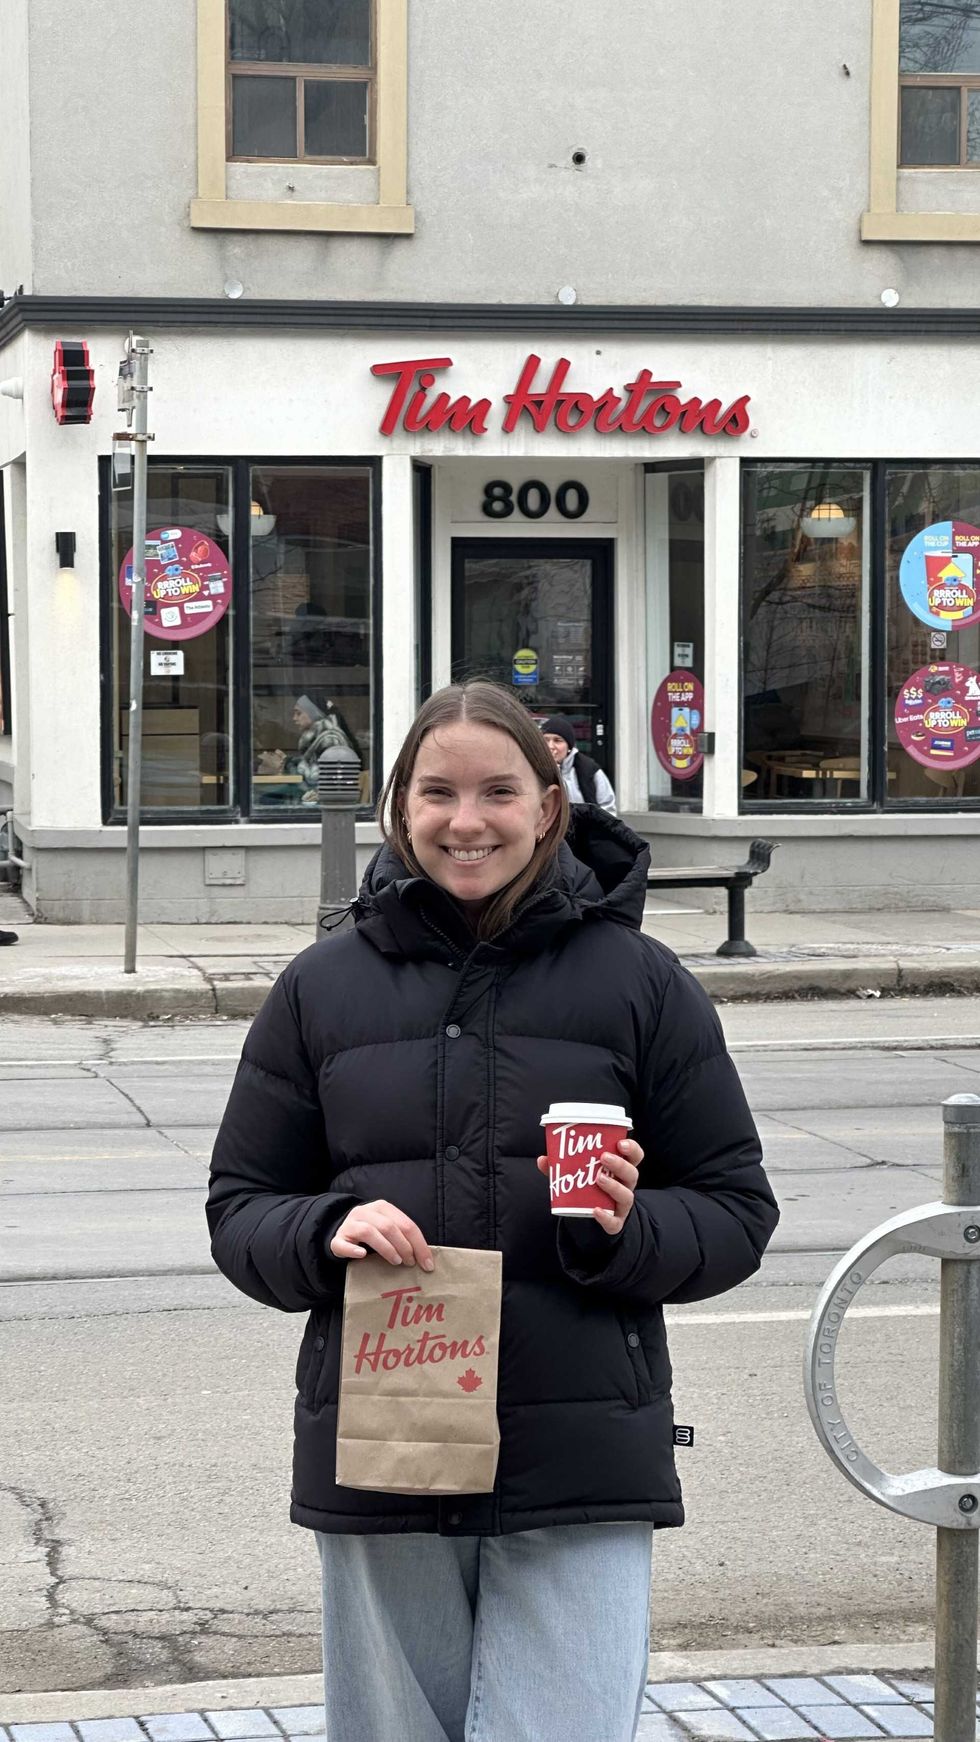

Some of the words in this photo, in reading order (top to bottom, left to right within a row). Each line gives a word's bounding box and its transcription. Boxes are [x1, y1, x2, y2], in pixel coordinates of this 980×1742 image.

[370, 357, 492, 437] Tim
[502, 353, 752, 437] Hortons
[482, 479, 589, 520] 800
[157, 577, 193, 590] RRROLL
[180, 583, 200, 595] WIN
[933, 588, 968, 598] RRROLL
[955, 597, 974, 607] WIN
[667, 682, 683, 691] ROLL
[683, 682, 694, 691] ON
[668, 692, 681, 702] THE
[681, 692, 694, 701] APP
[929, 710, 961, 719] RRROLL
[950, 718, 967, 727] WIN
[552, 1122, 603, 1160] Tim
[549, 1156, 614, 1202] Hort
[381, 1285, 446, 1330] Tim
[817, 1270, 863, 1368] TORONTO
[353, 1330, 486, 1375] Hortons
[817, 1383, 833, 1406] OF
[827, 1418, 859, 1463] CITY
